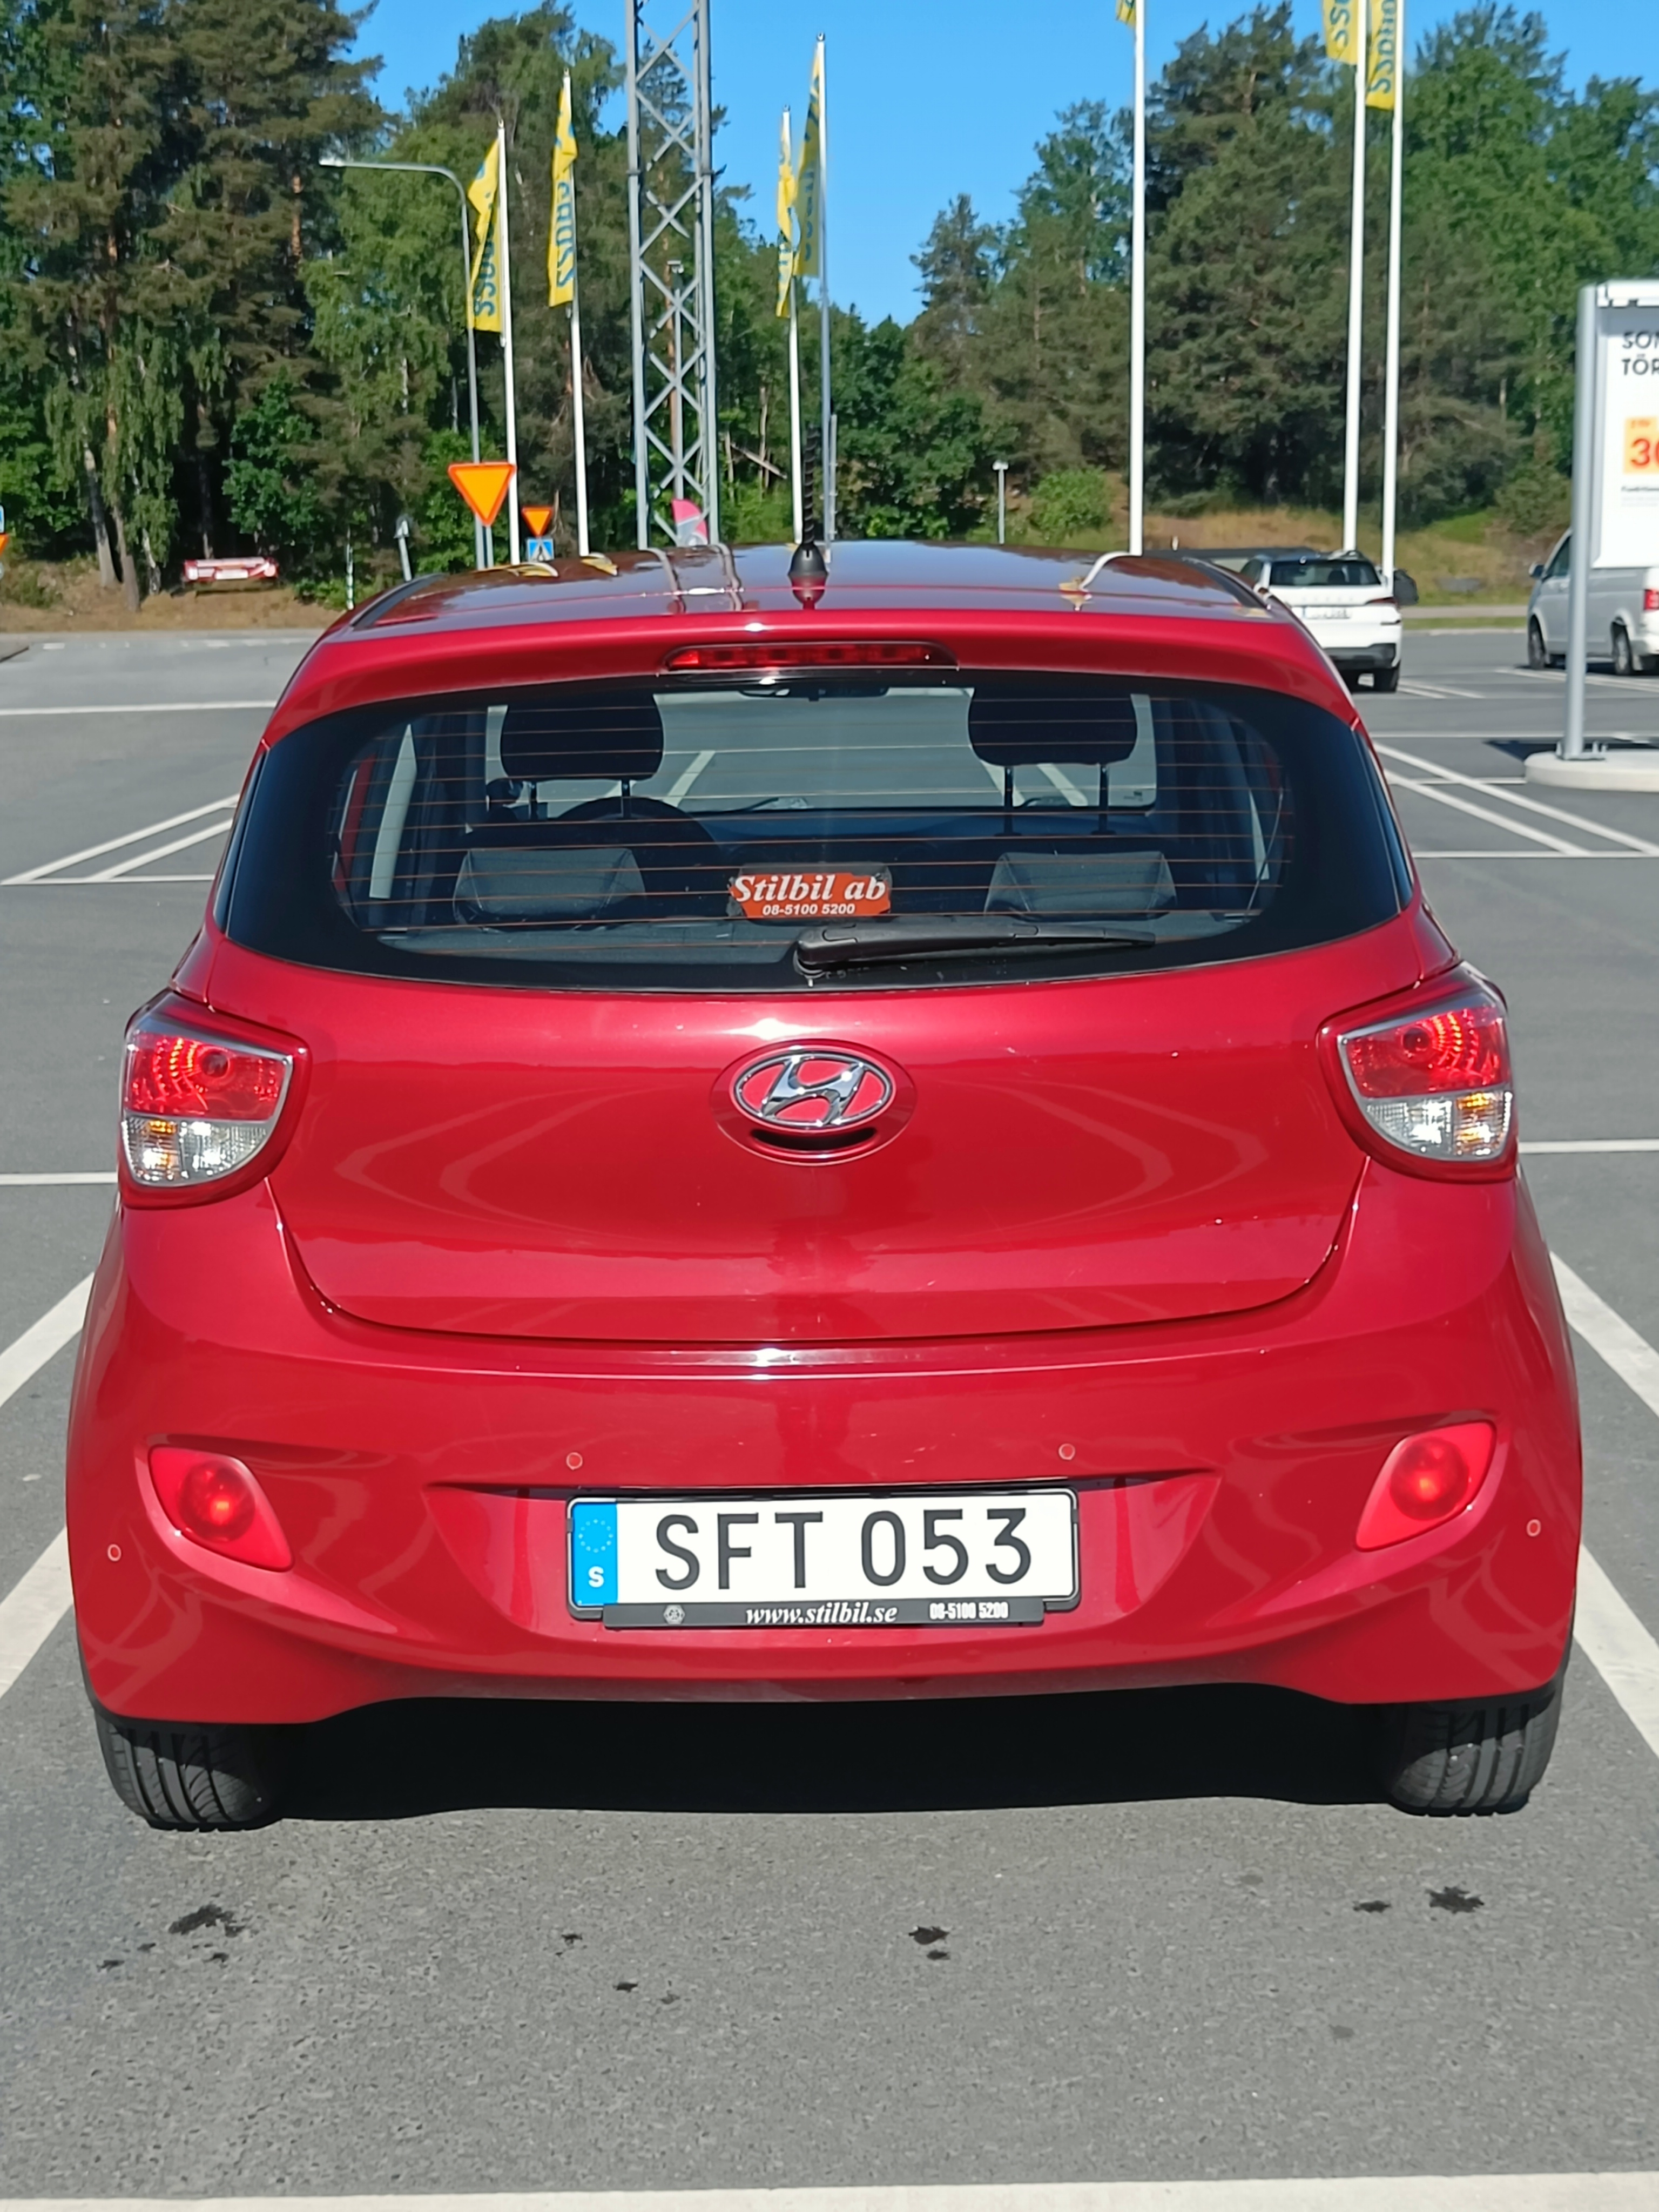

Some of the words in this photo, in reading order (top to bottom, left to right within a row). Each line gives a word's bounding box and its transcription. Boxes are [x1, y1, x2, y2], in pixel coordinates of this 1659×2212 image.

[1622, 331, 1659, 349] SO
[1631, 438, 1659, 468] 3
[735, 874, 835, 902] Stilbil
[844, 876, 886, 900] ab
[762, 903, 818, 916] 08-5100
[821, 903, 855, 915] 5200
[656, 1510, 824, 1590] SFT
[861, 1508, 1031, 1587] 053
[588, 1566, 604, 1588] S
[745, 1601, 898, 1624] www.stilbil.se
[979, 1601, 1008, 1619] 5200
